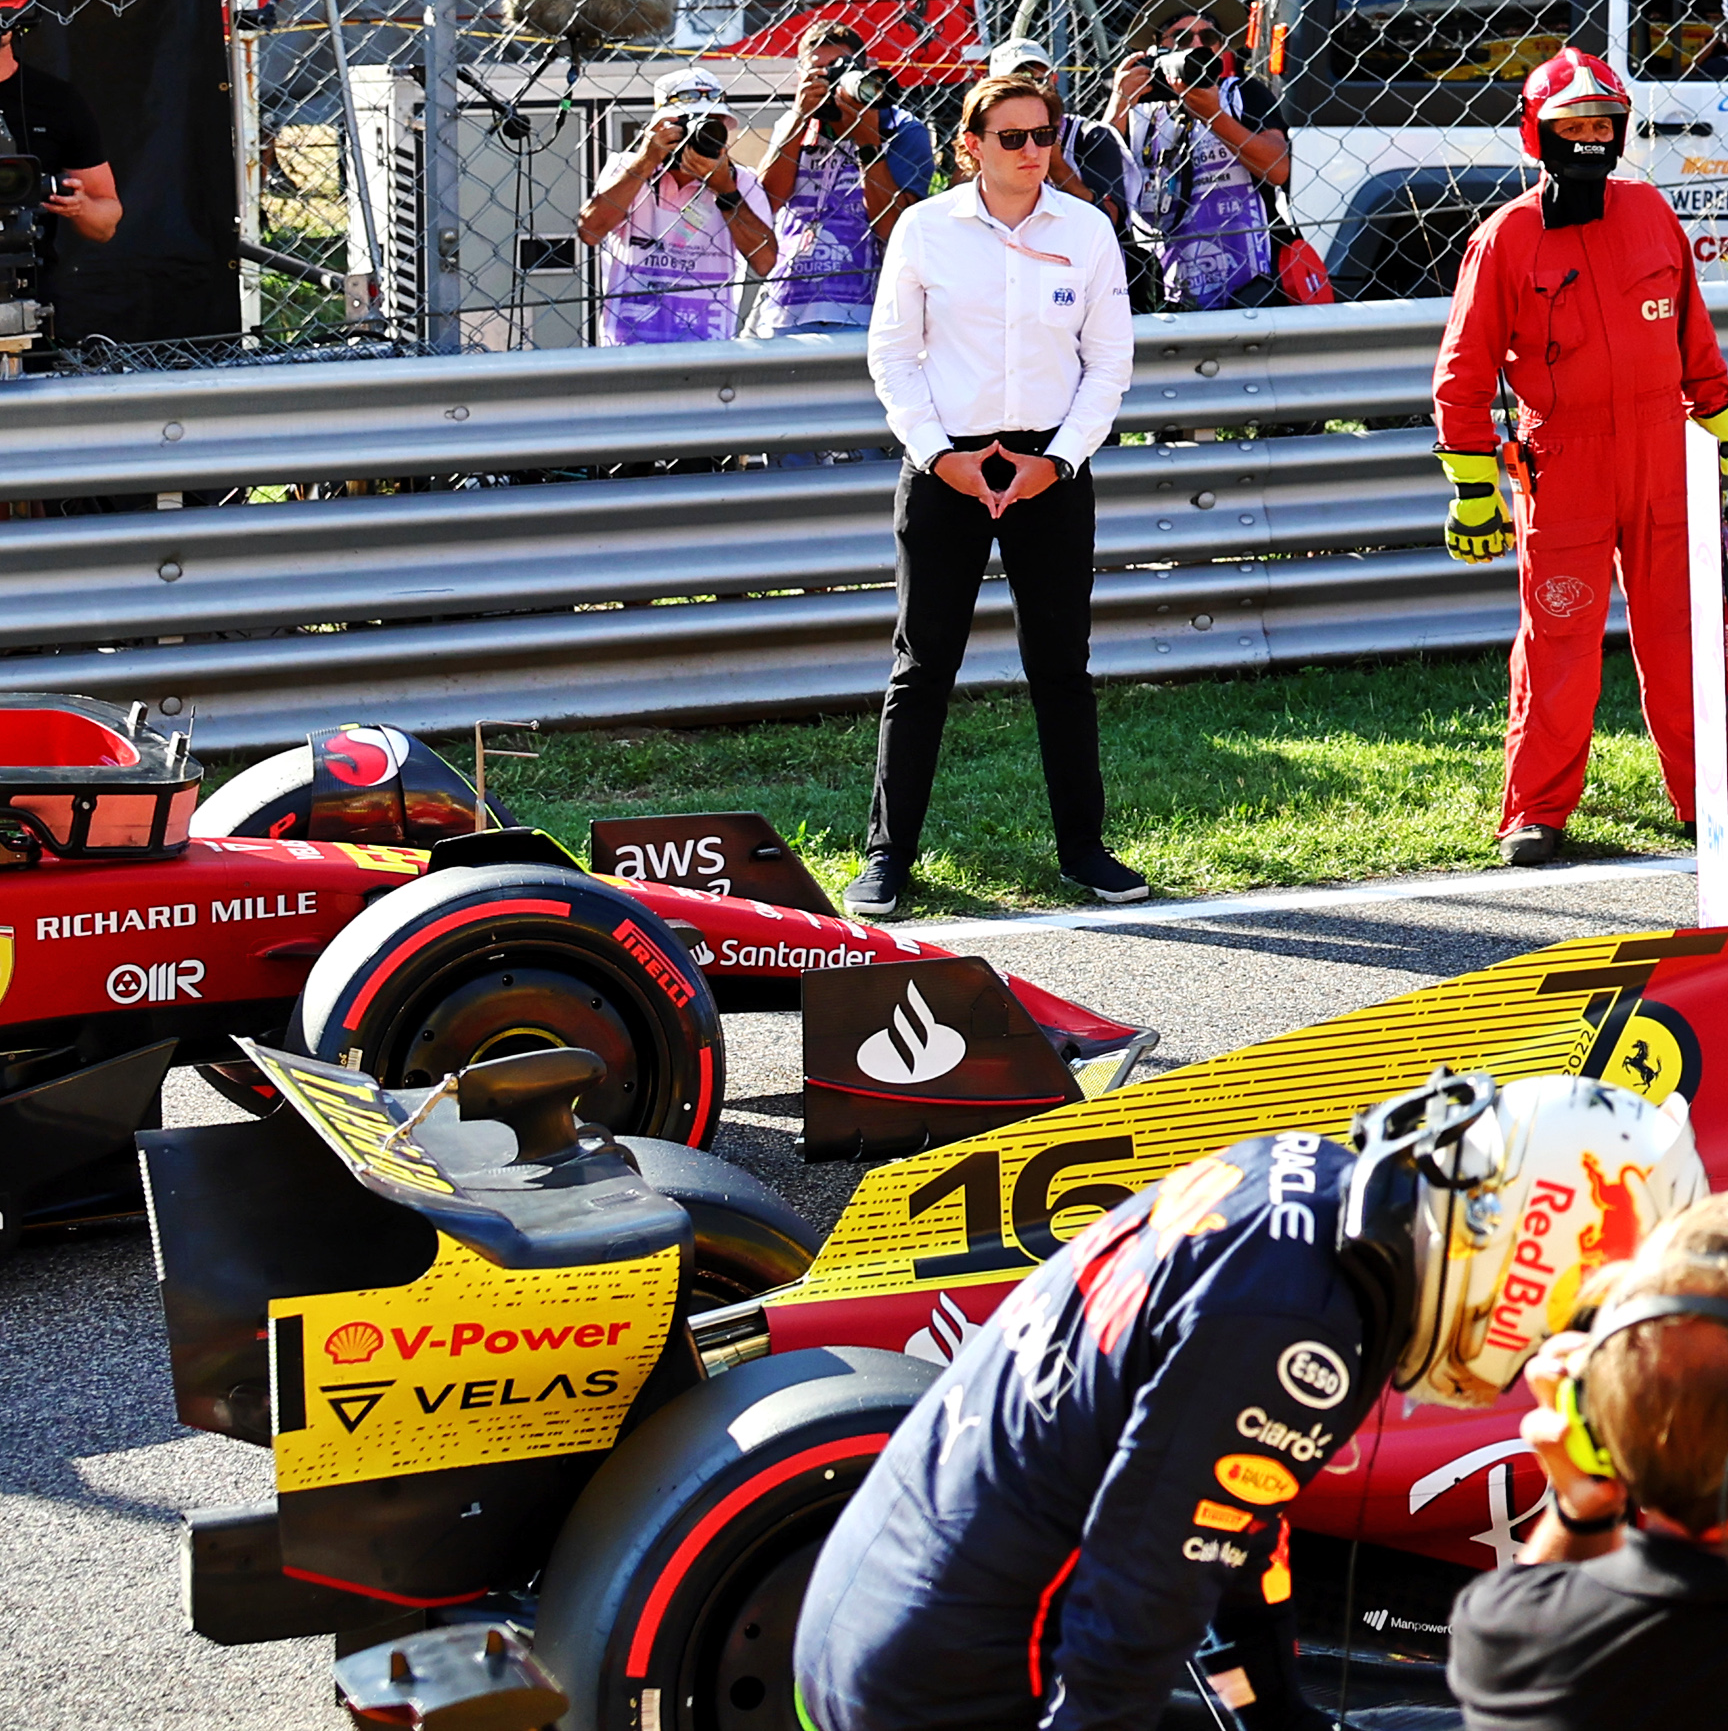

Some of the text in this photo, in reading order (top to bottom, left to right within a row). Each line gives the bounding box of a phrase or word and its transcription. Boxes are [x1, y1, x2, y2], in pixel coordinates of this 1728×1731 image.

[1217, 199, 1242, 216] FIA
[1053, 289, 1076, 306] FIA
[614, 834, 727, 881] aws
[35, 891, 319, 942] RICHARD MILLE
[611, 917, 697, 1009] PIRELLI
[718, 939, 878, 970] Santander
[907, 1133, 1138, 1280] 16
[390, 1320, 631, 1360] V-Power
[1290, 1351, 1337, 1396] Esso
[1236, 1406, 1315, 1462] Claro
[1240, 1463, 1290, 1495] RAUCH
